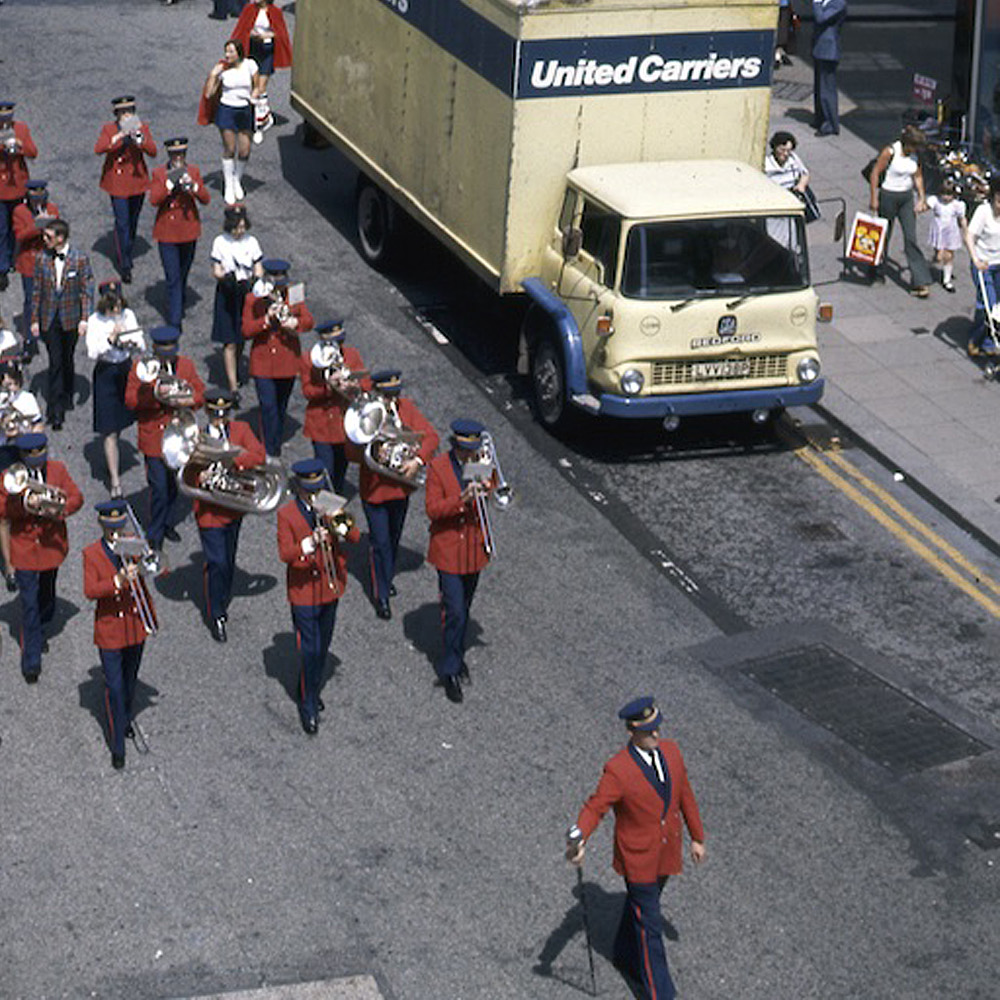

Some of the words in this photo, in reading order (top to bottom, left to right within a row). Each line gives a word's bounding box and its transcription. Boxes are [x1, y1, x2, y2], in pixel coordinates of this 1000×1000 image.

[531, 56, 638, 88] United
[638, 53, 762, 83] Carriers
[691, 333, 761, 349] BEDFORD
